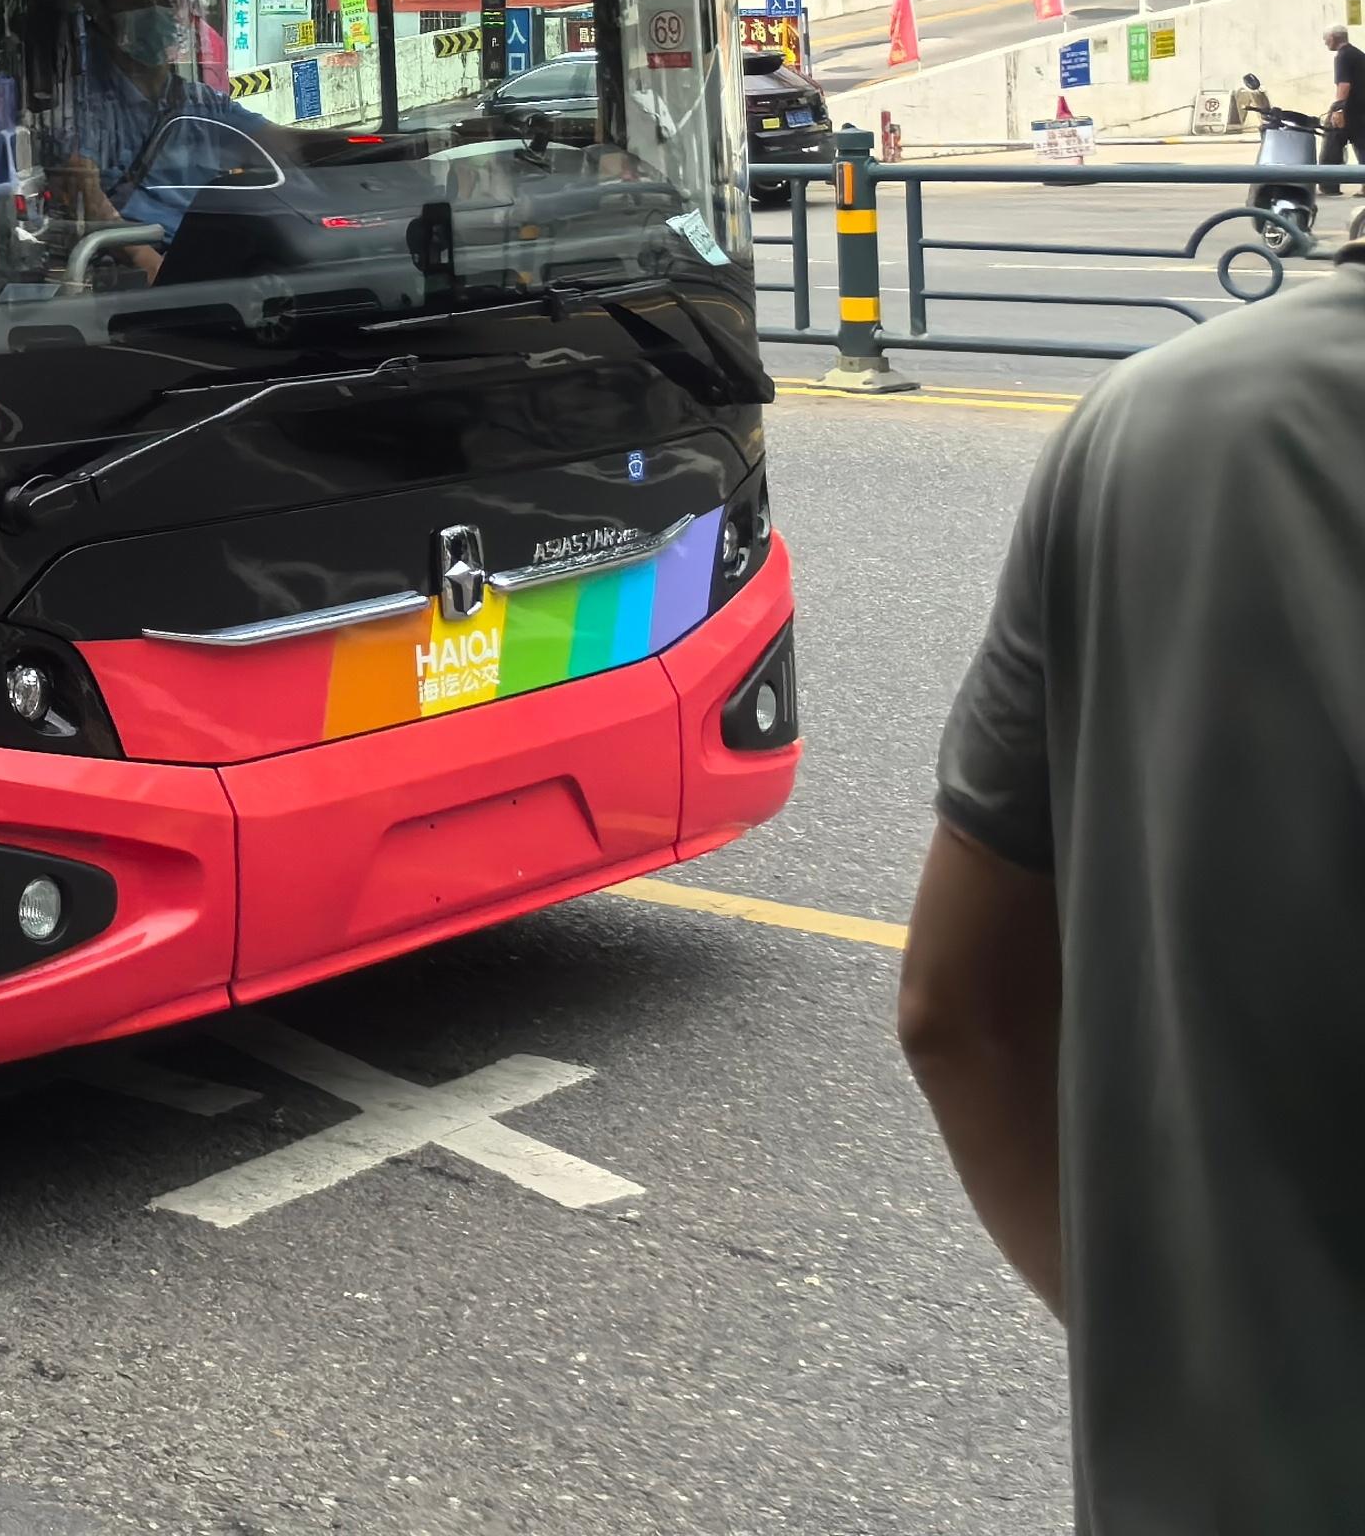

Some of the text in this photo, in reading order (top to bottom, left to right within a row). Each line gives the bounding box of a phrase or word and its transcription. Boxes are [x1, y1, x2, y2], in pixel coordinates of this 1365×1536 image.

[771, 0, 796, 9] 入口
[506, 18, 528, 76] 入口
[655, 16, 681, 44] 69
[418, 663, 501, 704] 海汽公交
